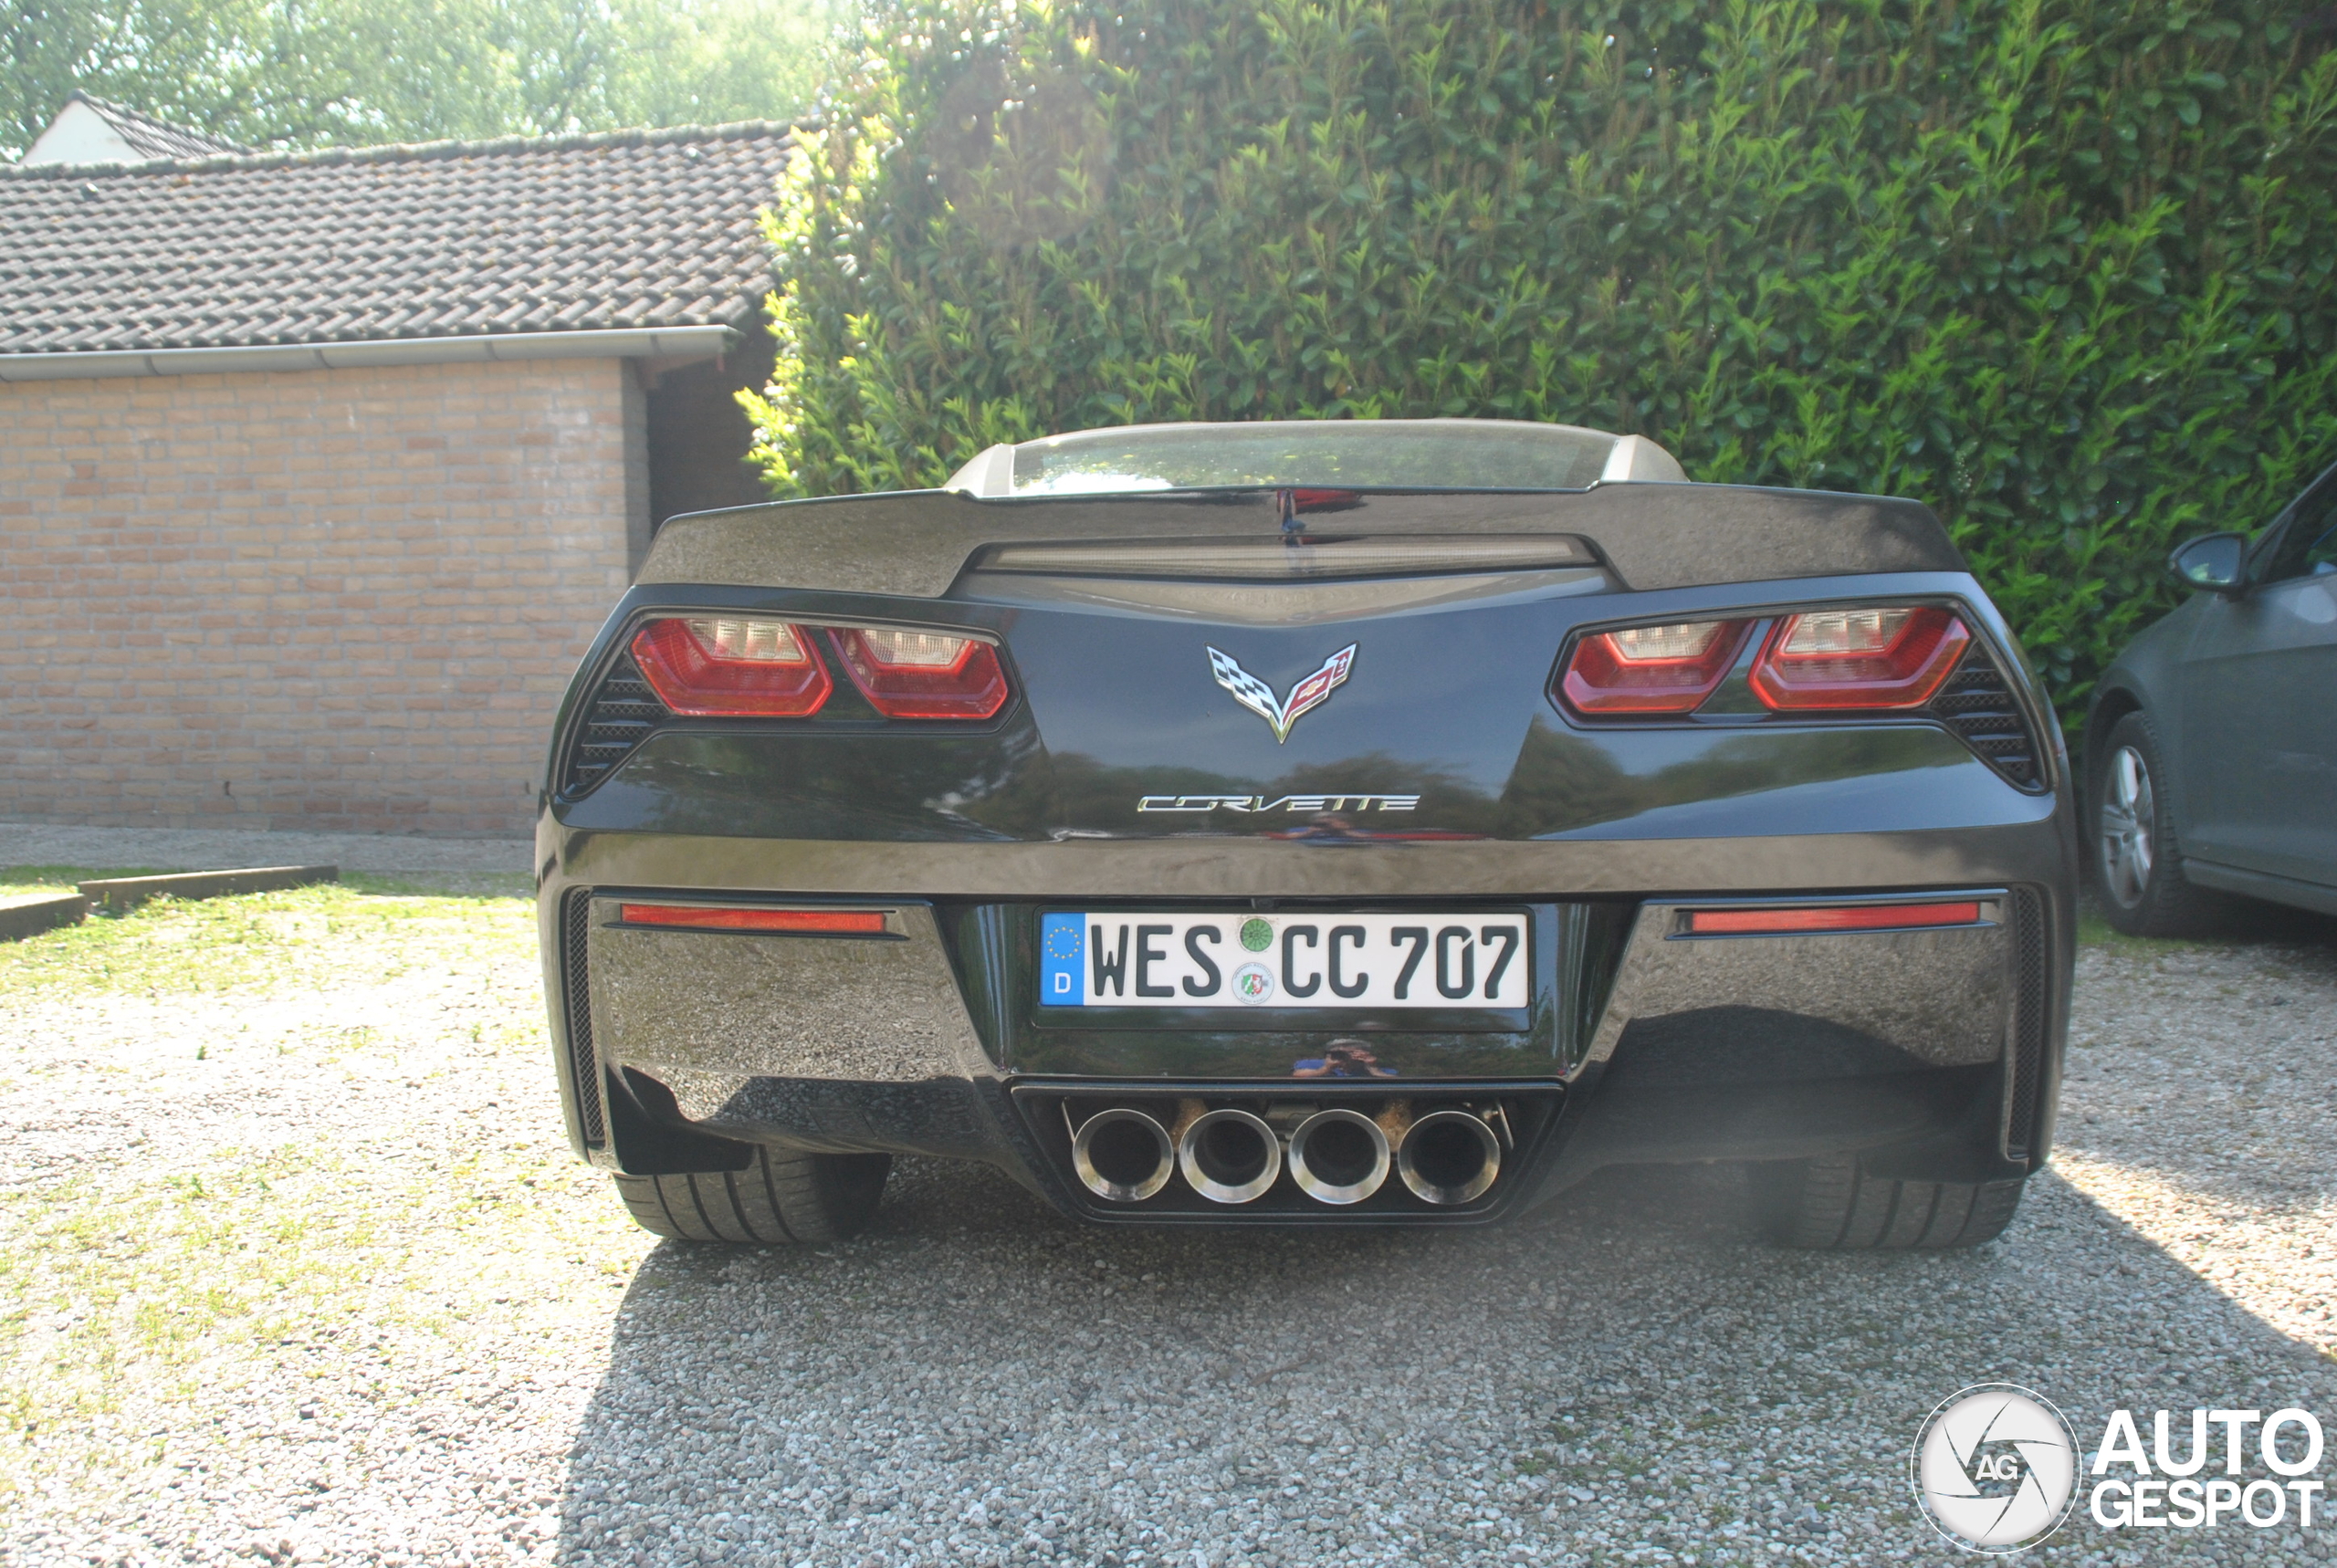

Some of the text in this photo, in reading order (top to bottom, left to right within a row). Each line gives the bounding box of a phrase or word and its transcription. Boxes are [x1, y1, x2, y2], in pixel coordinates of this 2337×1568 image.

[1137, 794, 1420, 812] CORVETTE
[1090, 924, 1519, 999] WES CC 707
[1053, 972, 1072, 994] D
